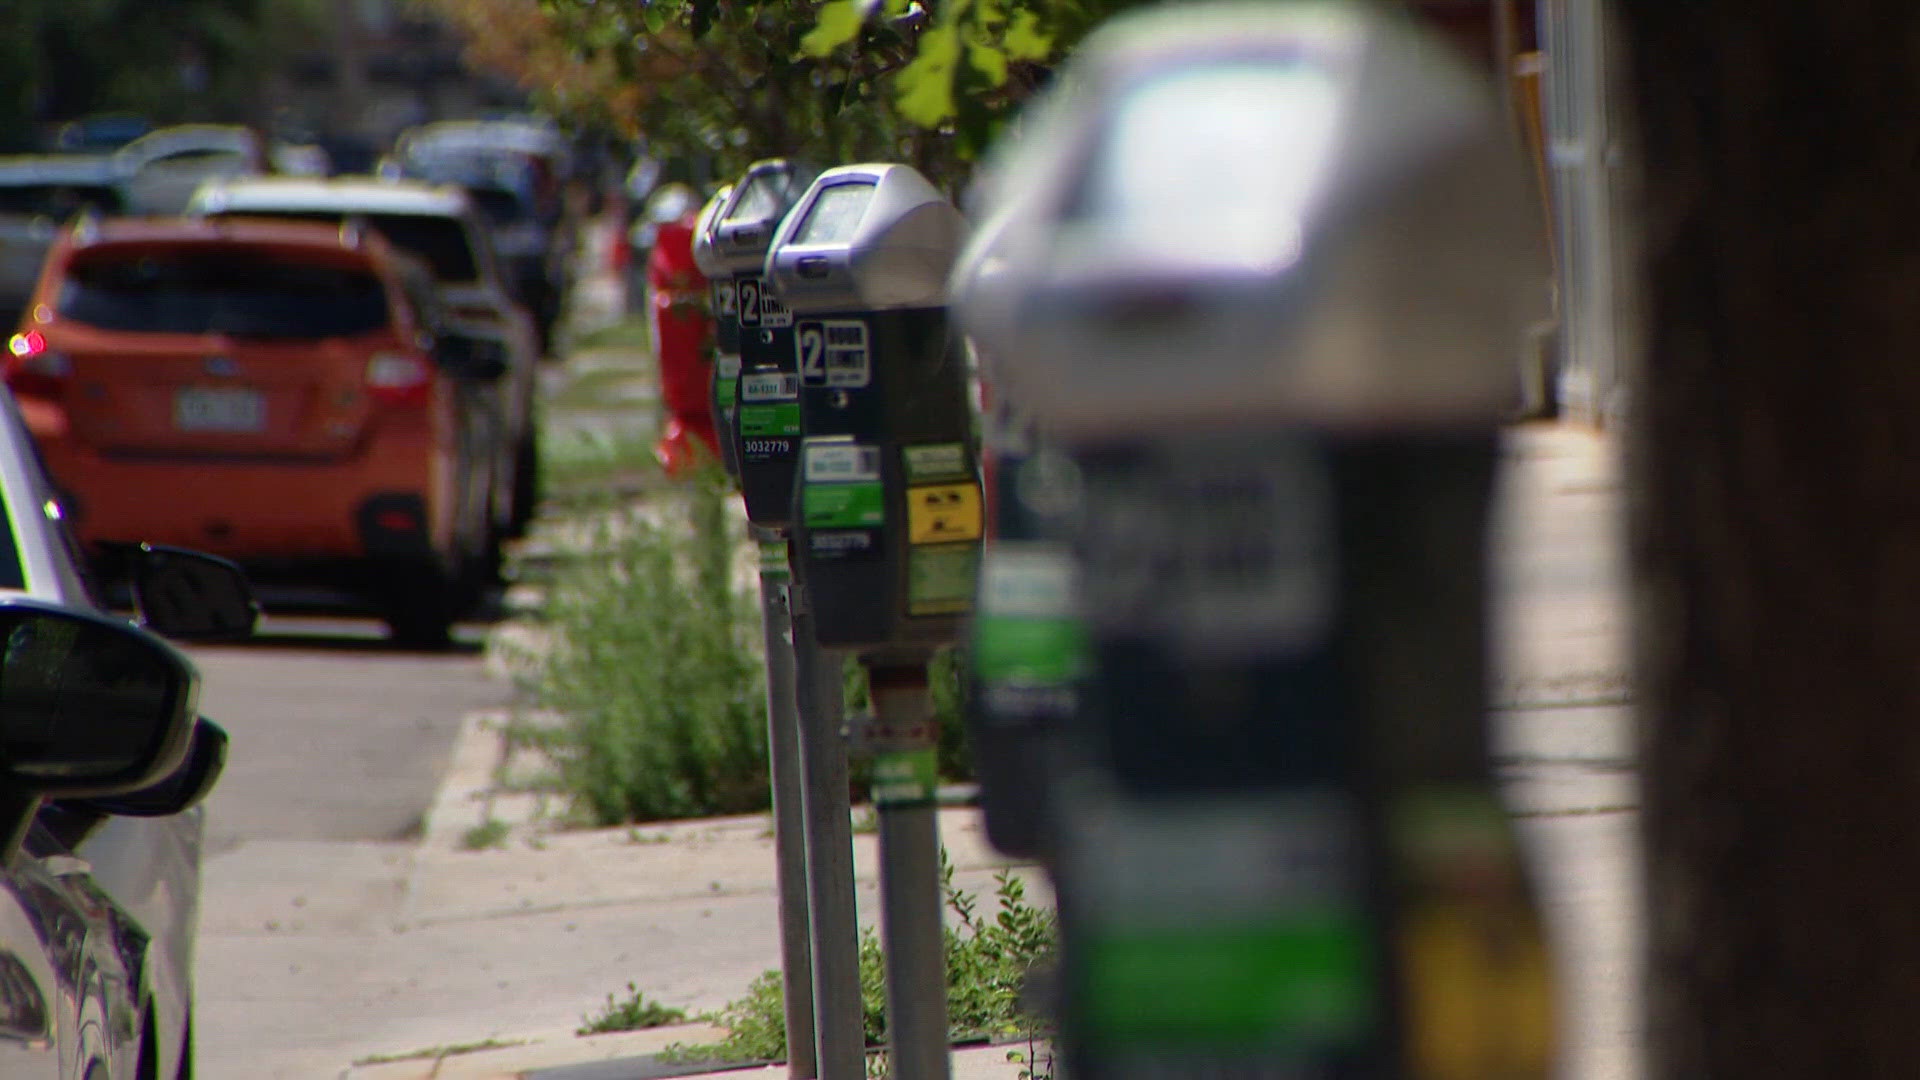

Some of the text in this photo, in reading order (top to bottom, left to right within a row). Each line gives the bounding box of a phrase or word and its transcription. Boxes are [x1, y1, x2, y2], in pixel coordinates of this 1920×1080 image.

[720, 285, 735, 315] 2
[742, 283, 758, 322] 2
[803, 328, 821, 377] 2
[745, 440, 789, 453] 3032779
